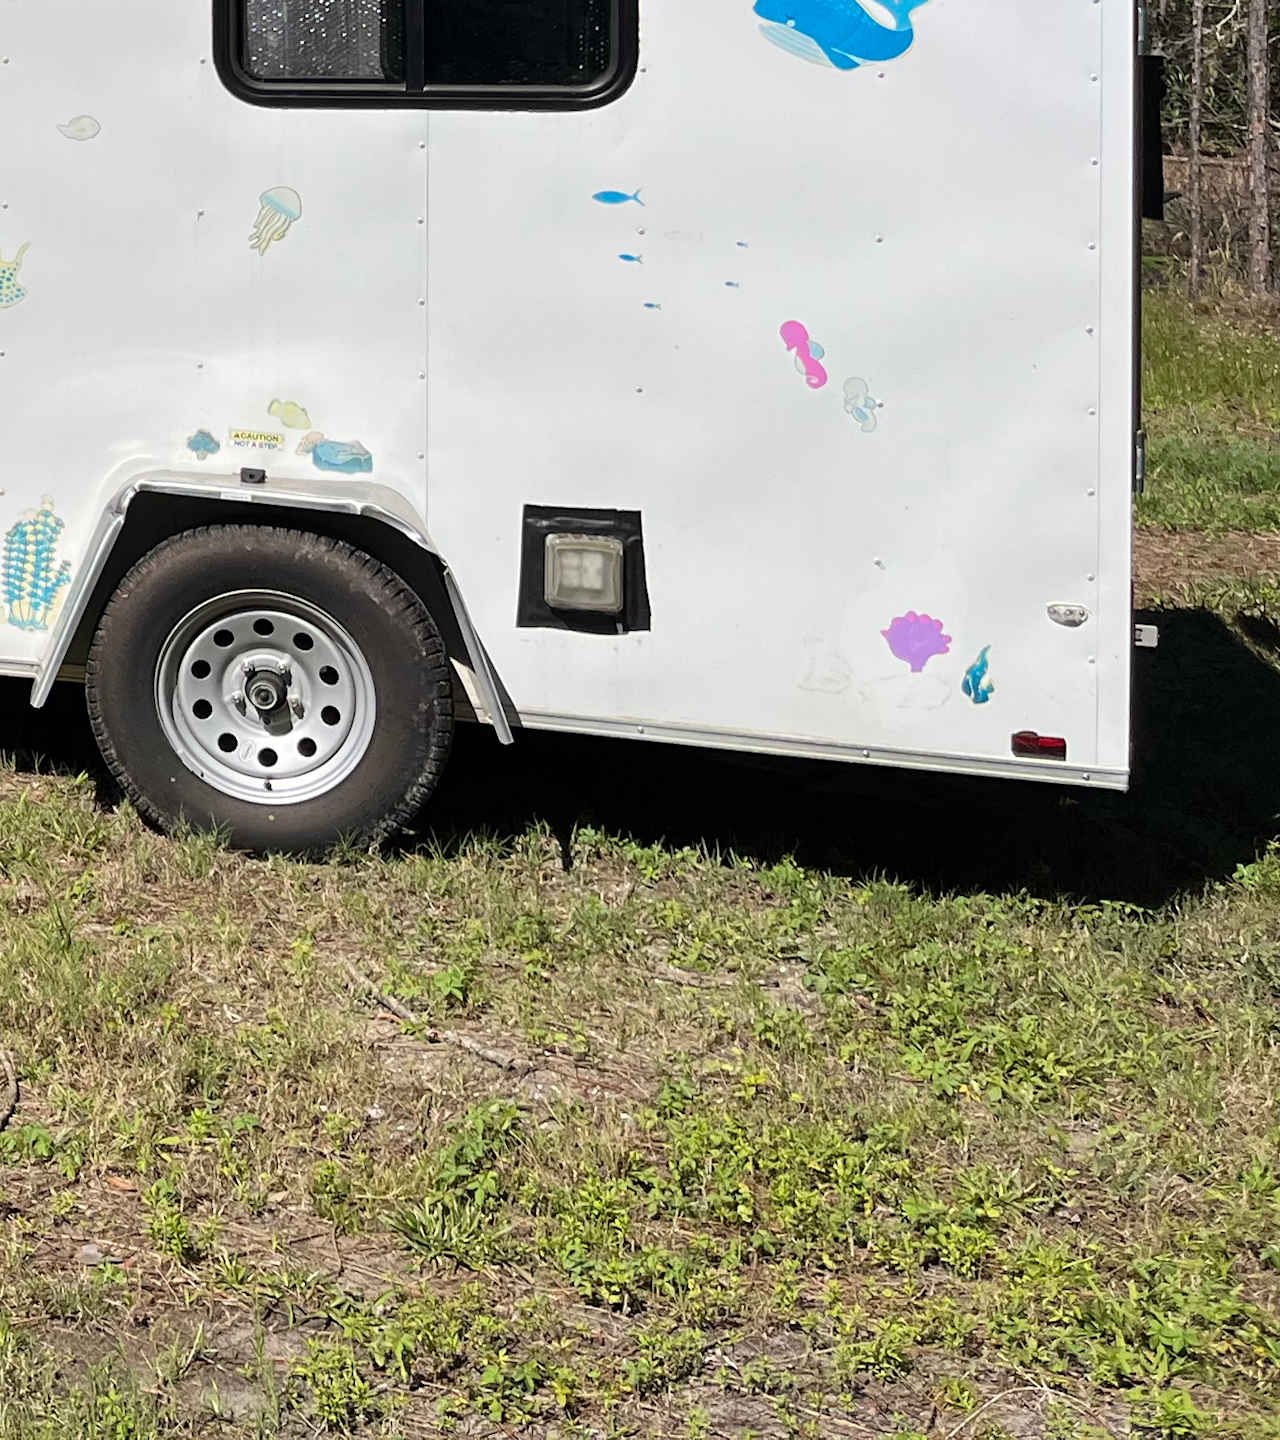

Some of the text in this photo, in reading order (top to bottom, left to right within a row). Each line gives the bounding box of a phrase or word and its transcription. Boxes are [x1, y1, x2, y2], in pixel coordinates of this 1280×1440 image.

[240, 431, 279, 442] CAUTION
[233, 440, 250, 448] NOT
[251, 441, 257, 449] A
